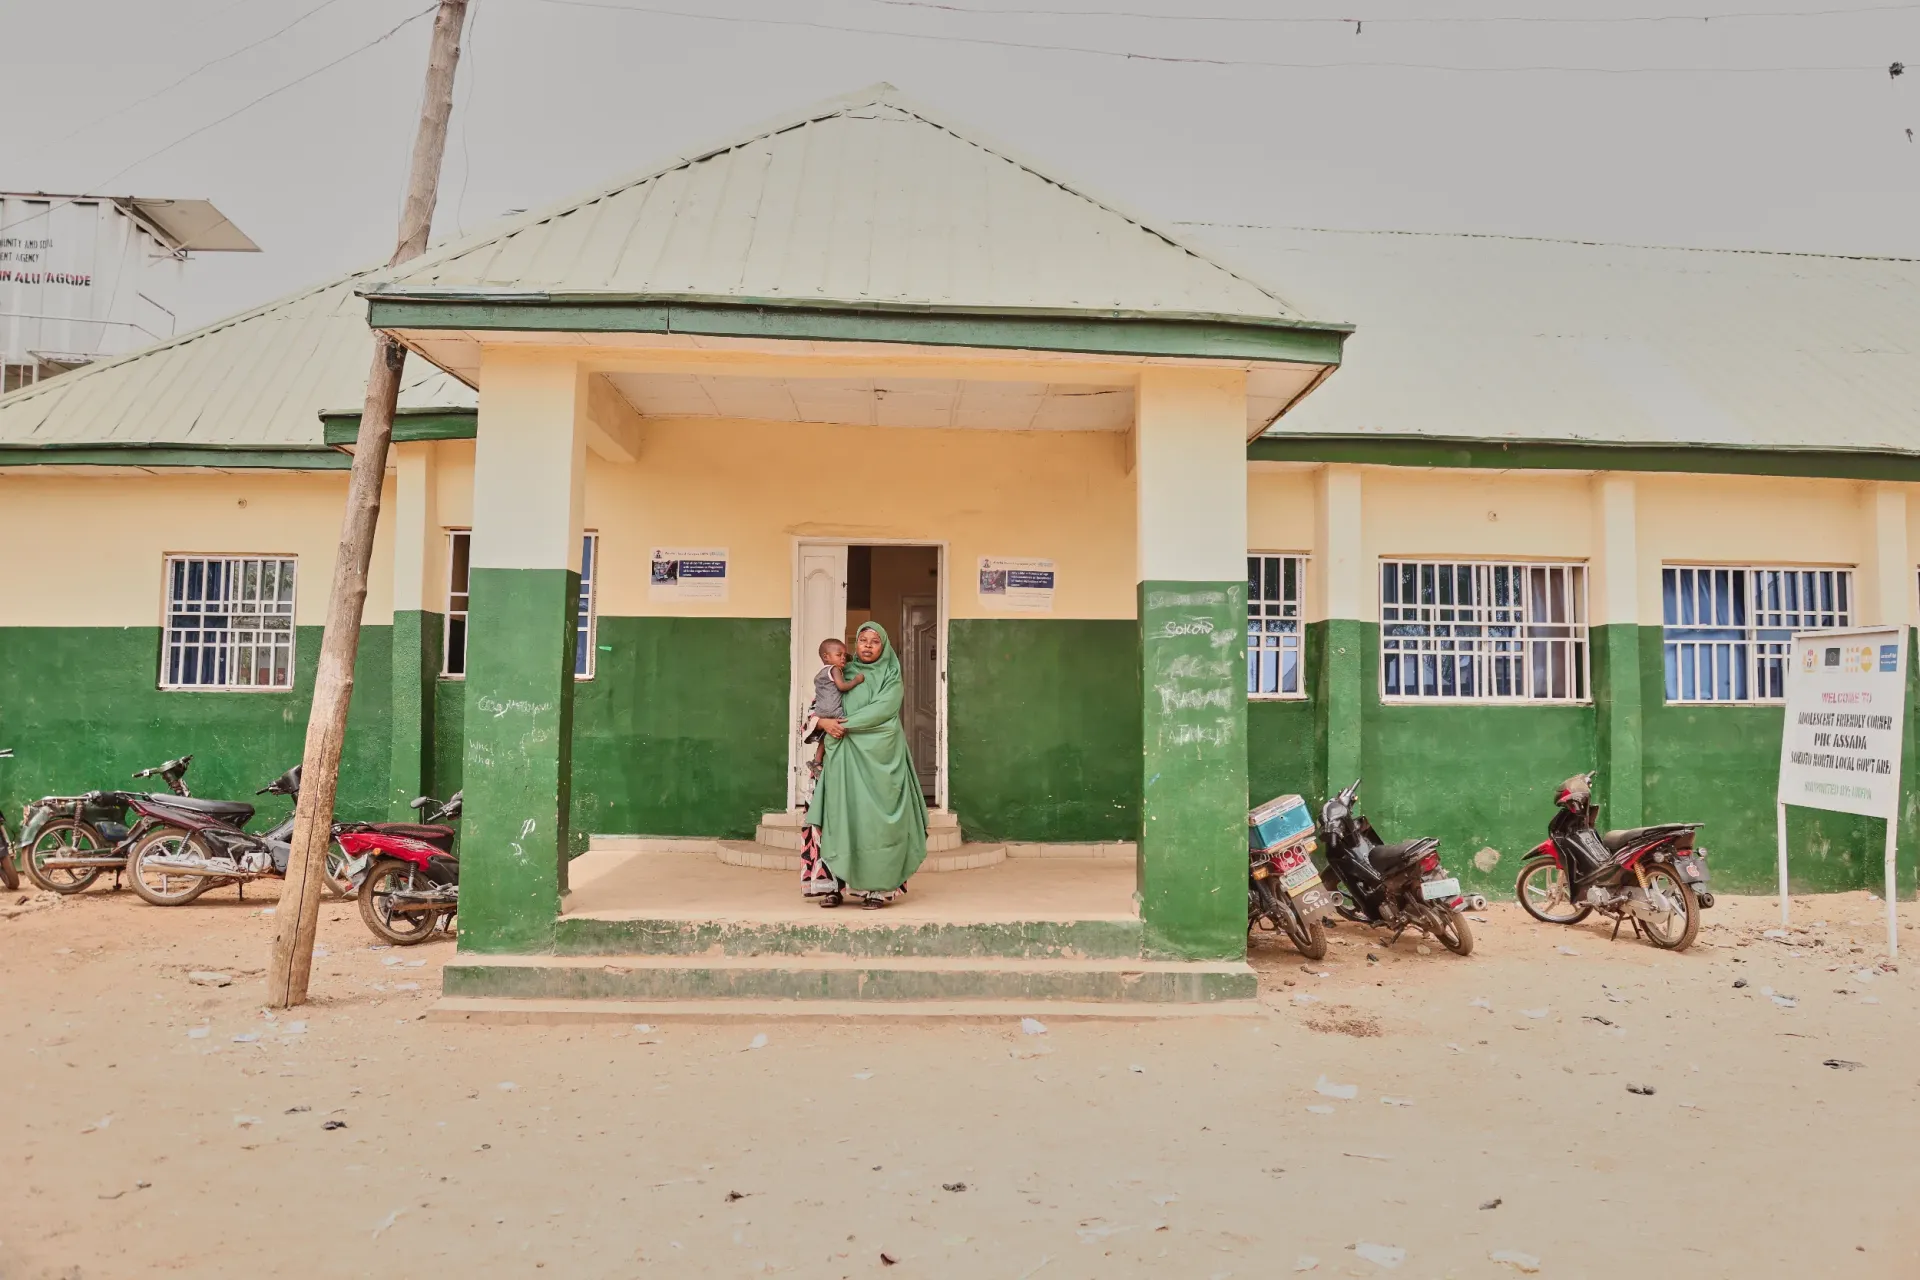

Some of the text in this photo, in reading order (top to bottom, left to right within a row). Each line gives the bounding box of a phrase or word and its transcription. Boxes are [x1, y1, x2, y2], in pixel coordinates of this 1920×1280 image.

[16, 253, 39, 263] AGENCY
[1822, 692, 1860, 704] WELCOME
[1836, 713, 1866, 729] FRIENDLY
[1814, 732, 1867, 750] PHC ASSADA
[1836, 755, 1854, 772] LOCAL
[1302, 897, 1330, 916] KASEA
